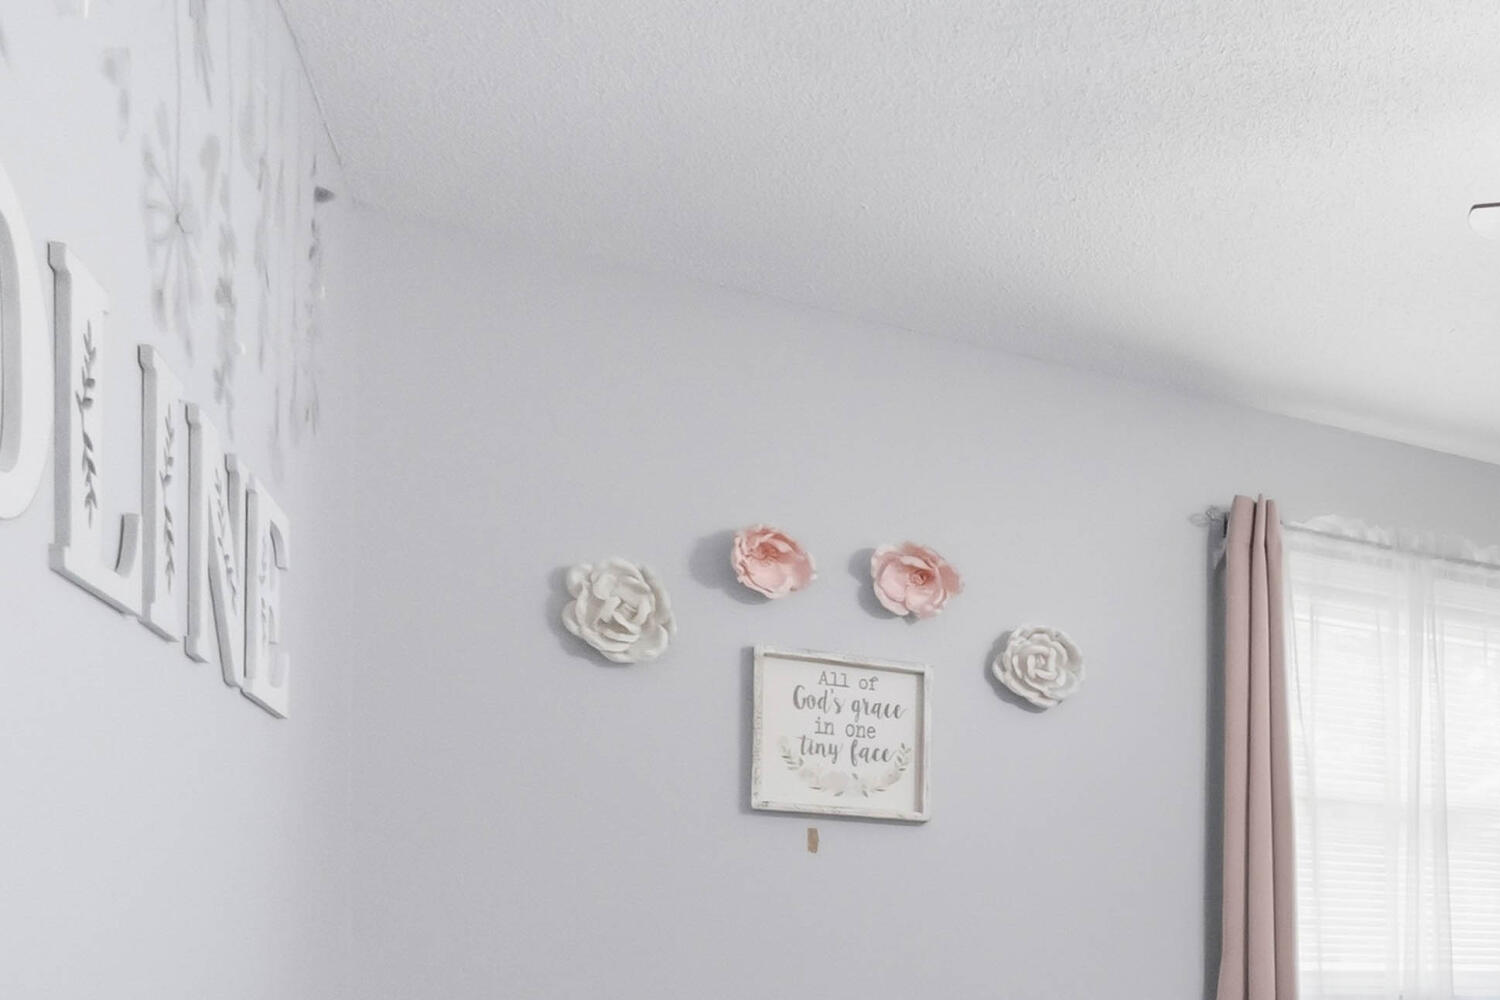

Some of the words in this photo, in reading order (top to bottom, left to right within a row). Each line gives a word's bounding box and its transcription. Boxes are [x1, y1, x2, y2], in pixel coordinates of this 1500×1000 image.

[818, 671, 850, 688] All
[858, 676, 879, 691] of
[793, 685, 844, 714] God's
[851, 698, 907, 723] grace
[814, 717, 835, 735] in
[845, 724, 876, 739] one
[799, 735, 843, 764] tiny
[850, 739, 898, 767] face
